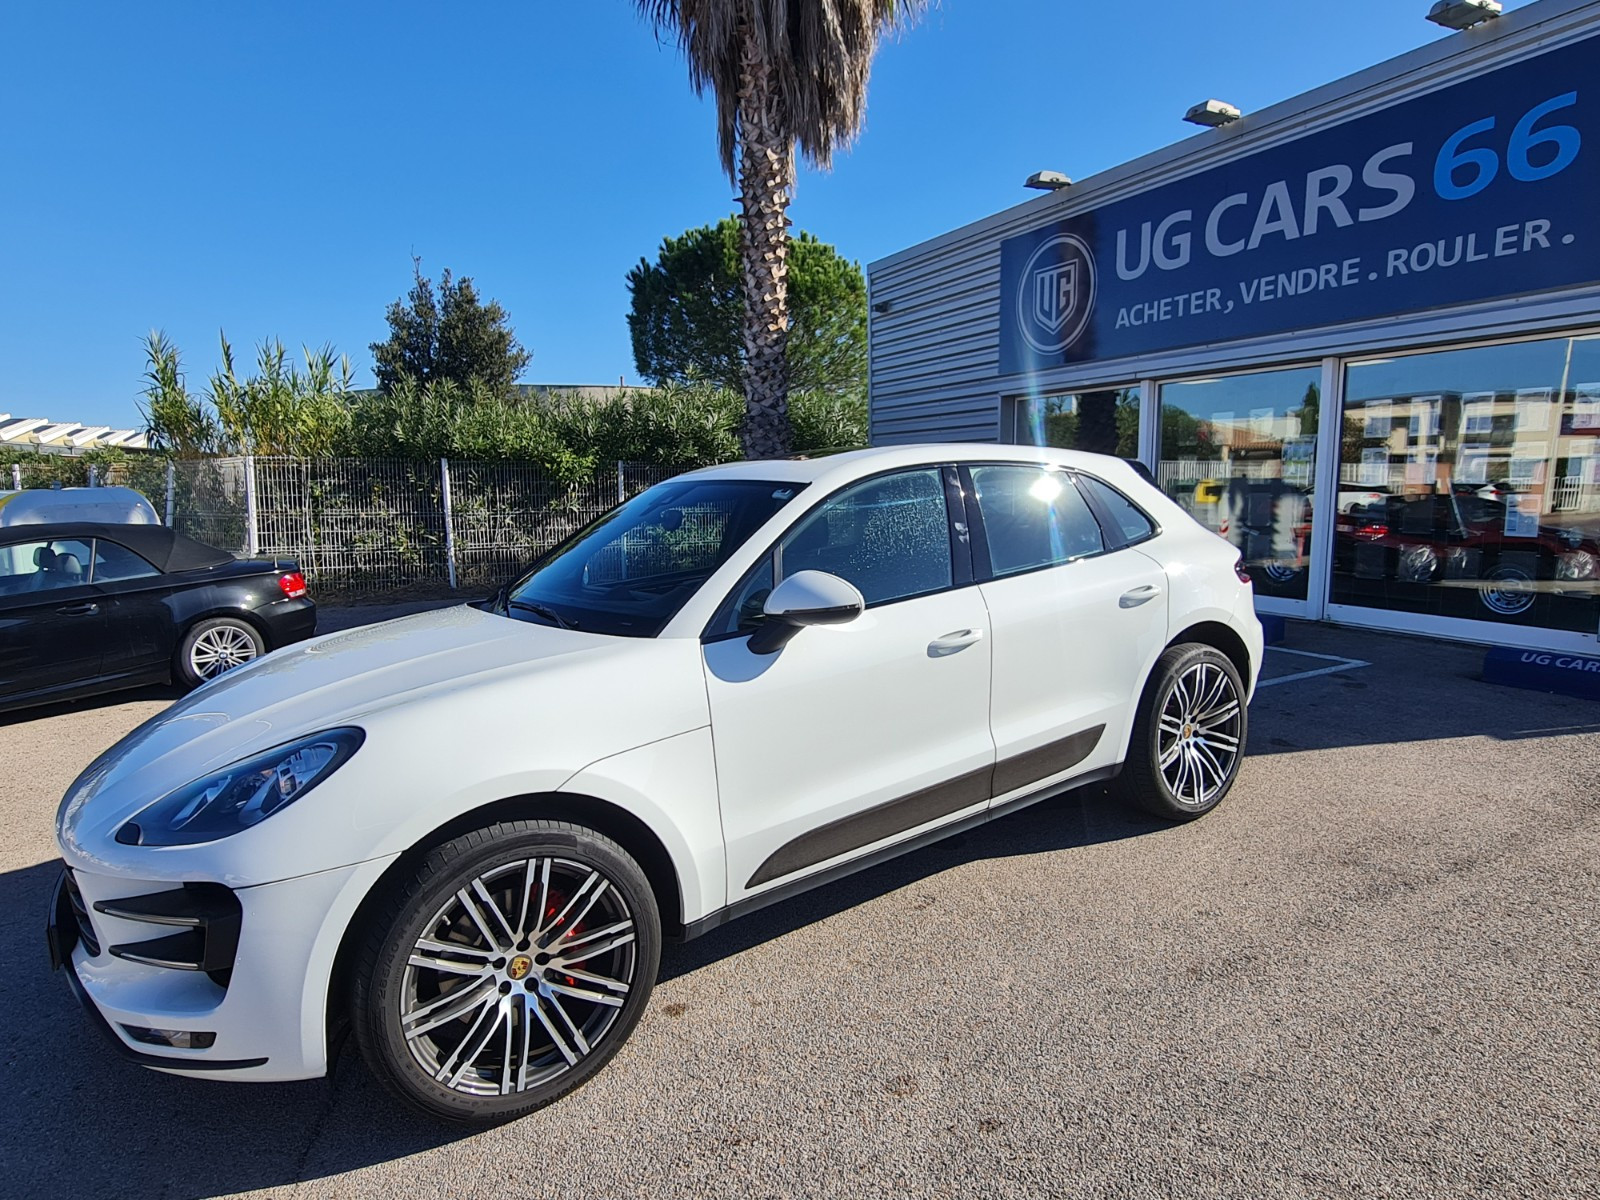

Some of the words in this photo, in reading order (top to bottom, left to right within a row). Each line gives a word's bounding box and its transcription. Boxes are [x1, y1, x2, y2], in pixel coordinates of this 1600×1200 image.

[1116, 210, 1192, 281] UG
[1205, 142, 1415, 257] CARS
[1433, 91, 1581, 200] 66
[1520, 652, 1552, 665] UG
[1555, 657, 1600, 673] CAR
